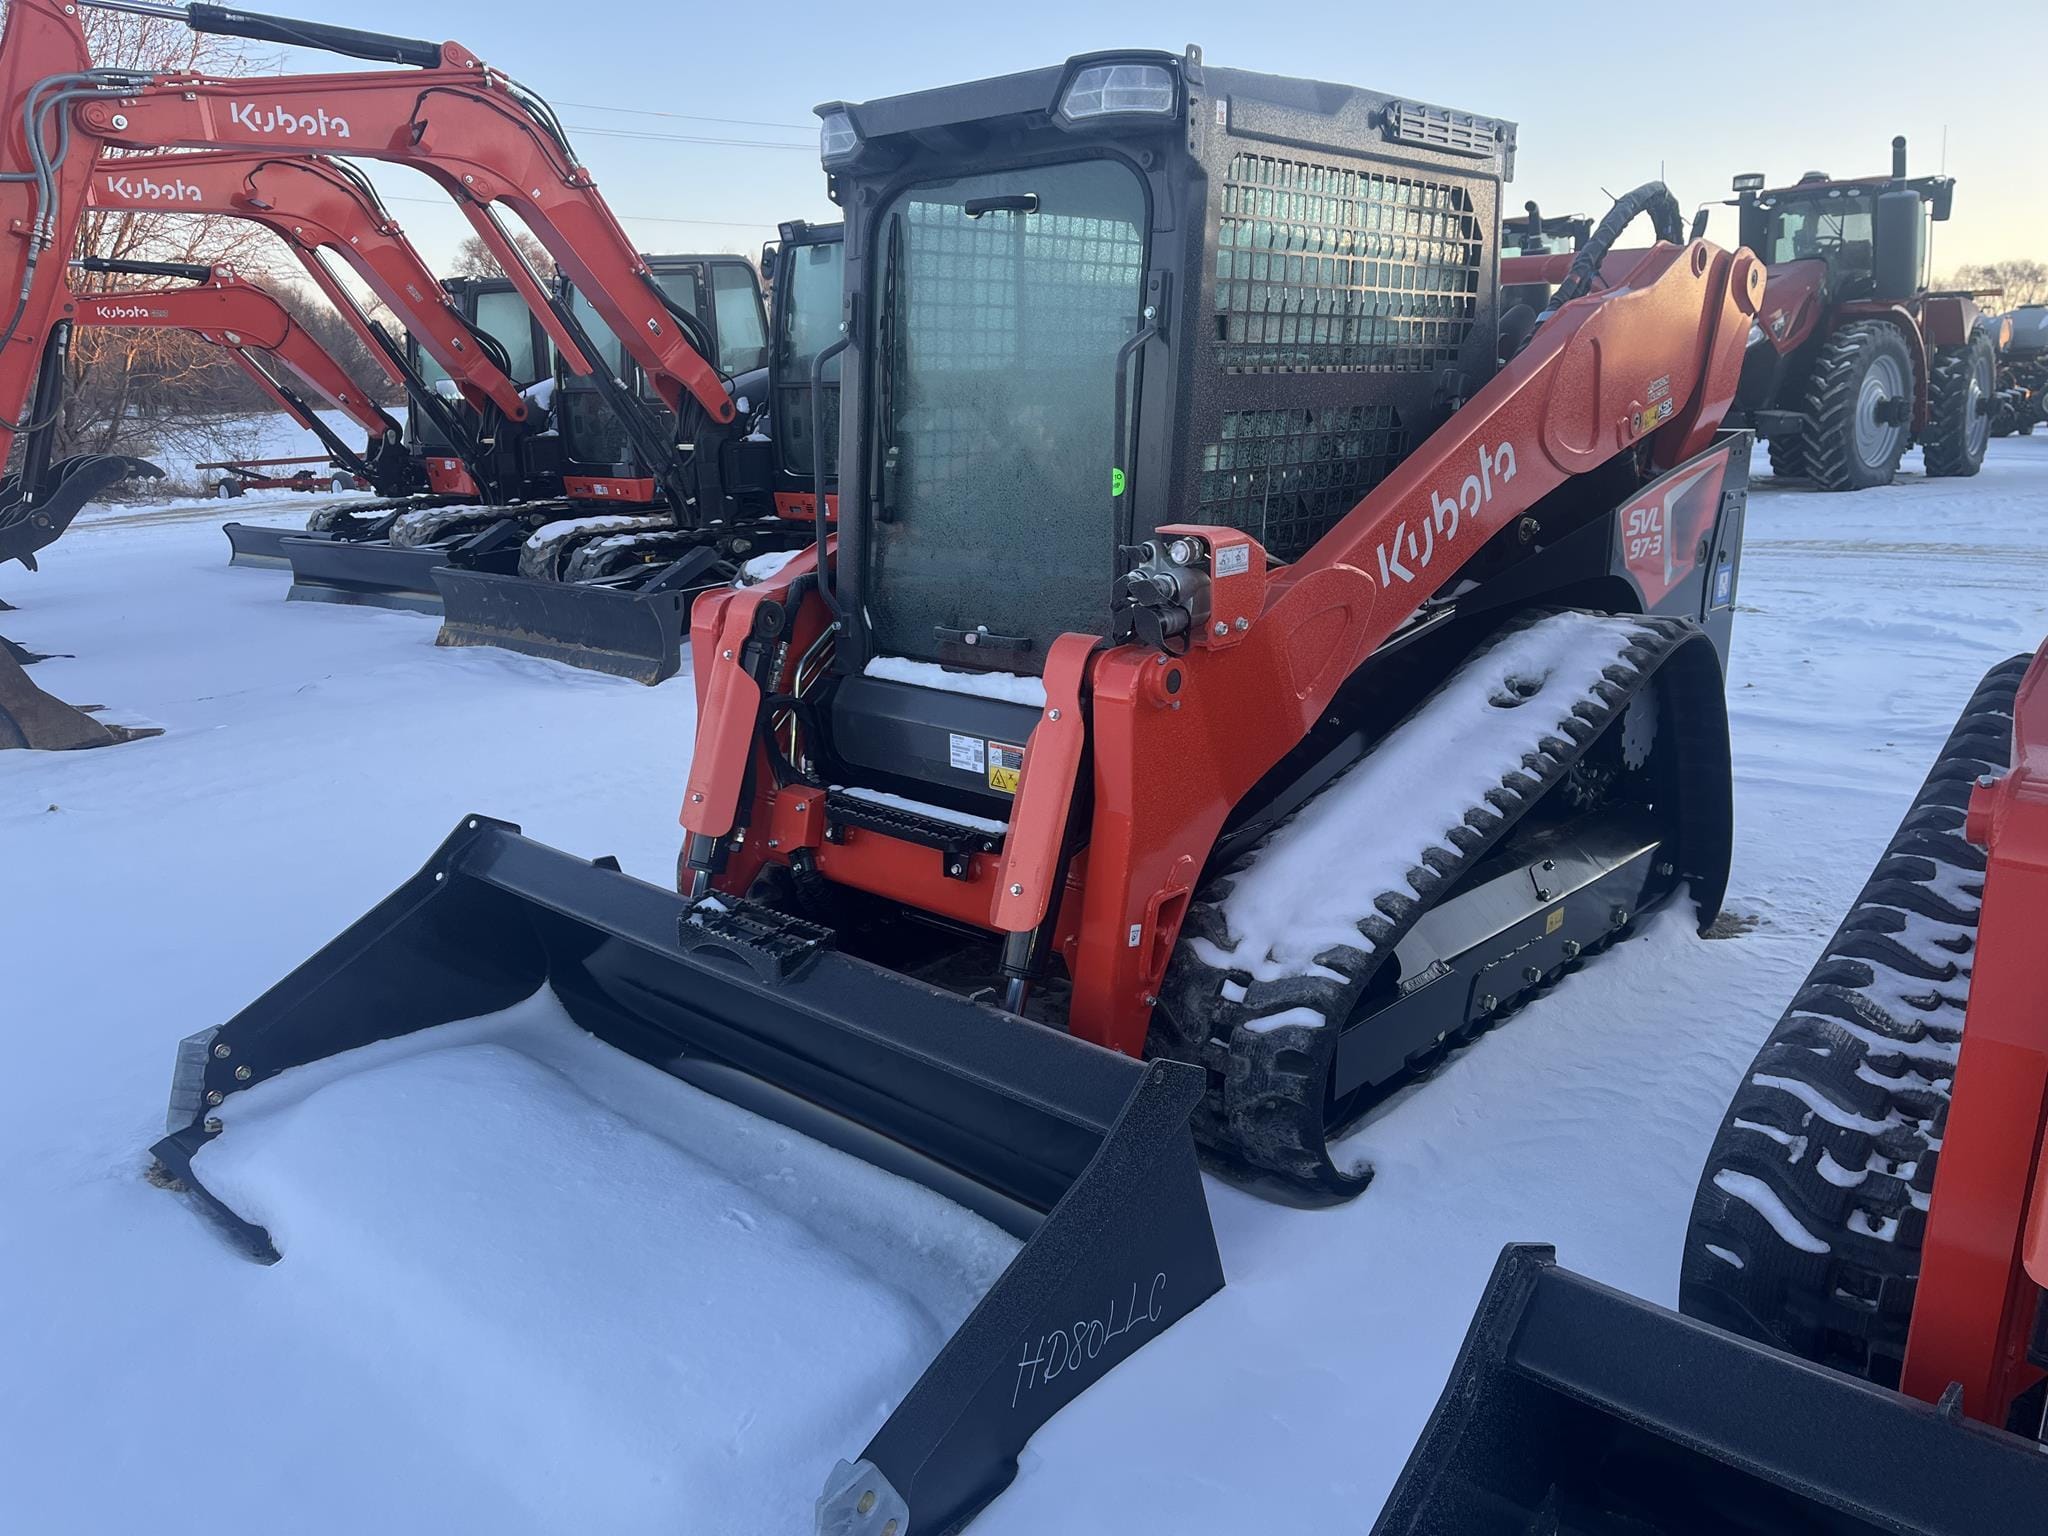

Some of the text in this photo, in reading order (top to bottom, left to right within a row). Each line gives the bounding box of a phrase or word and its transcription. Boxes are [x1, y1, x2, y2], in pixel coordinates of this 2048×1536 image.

[230, 102, 350, 138] Kubota
[108, 176, 202, 201] Kubota
[96, 305, 149, 319] Kubota
[1376, 441, 1517, 588] Kubota
[1626, 507, 1663, 536] SVL
[1629, 535, 1663, 560] 97-3
